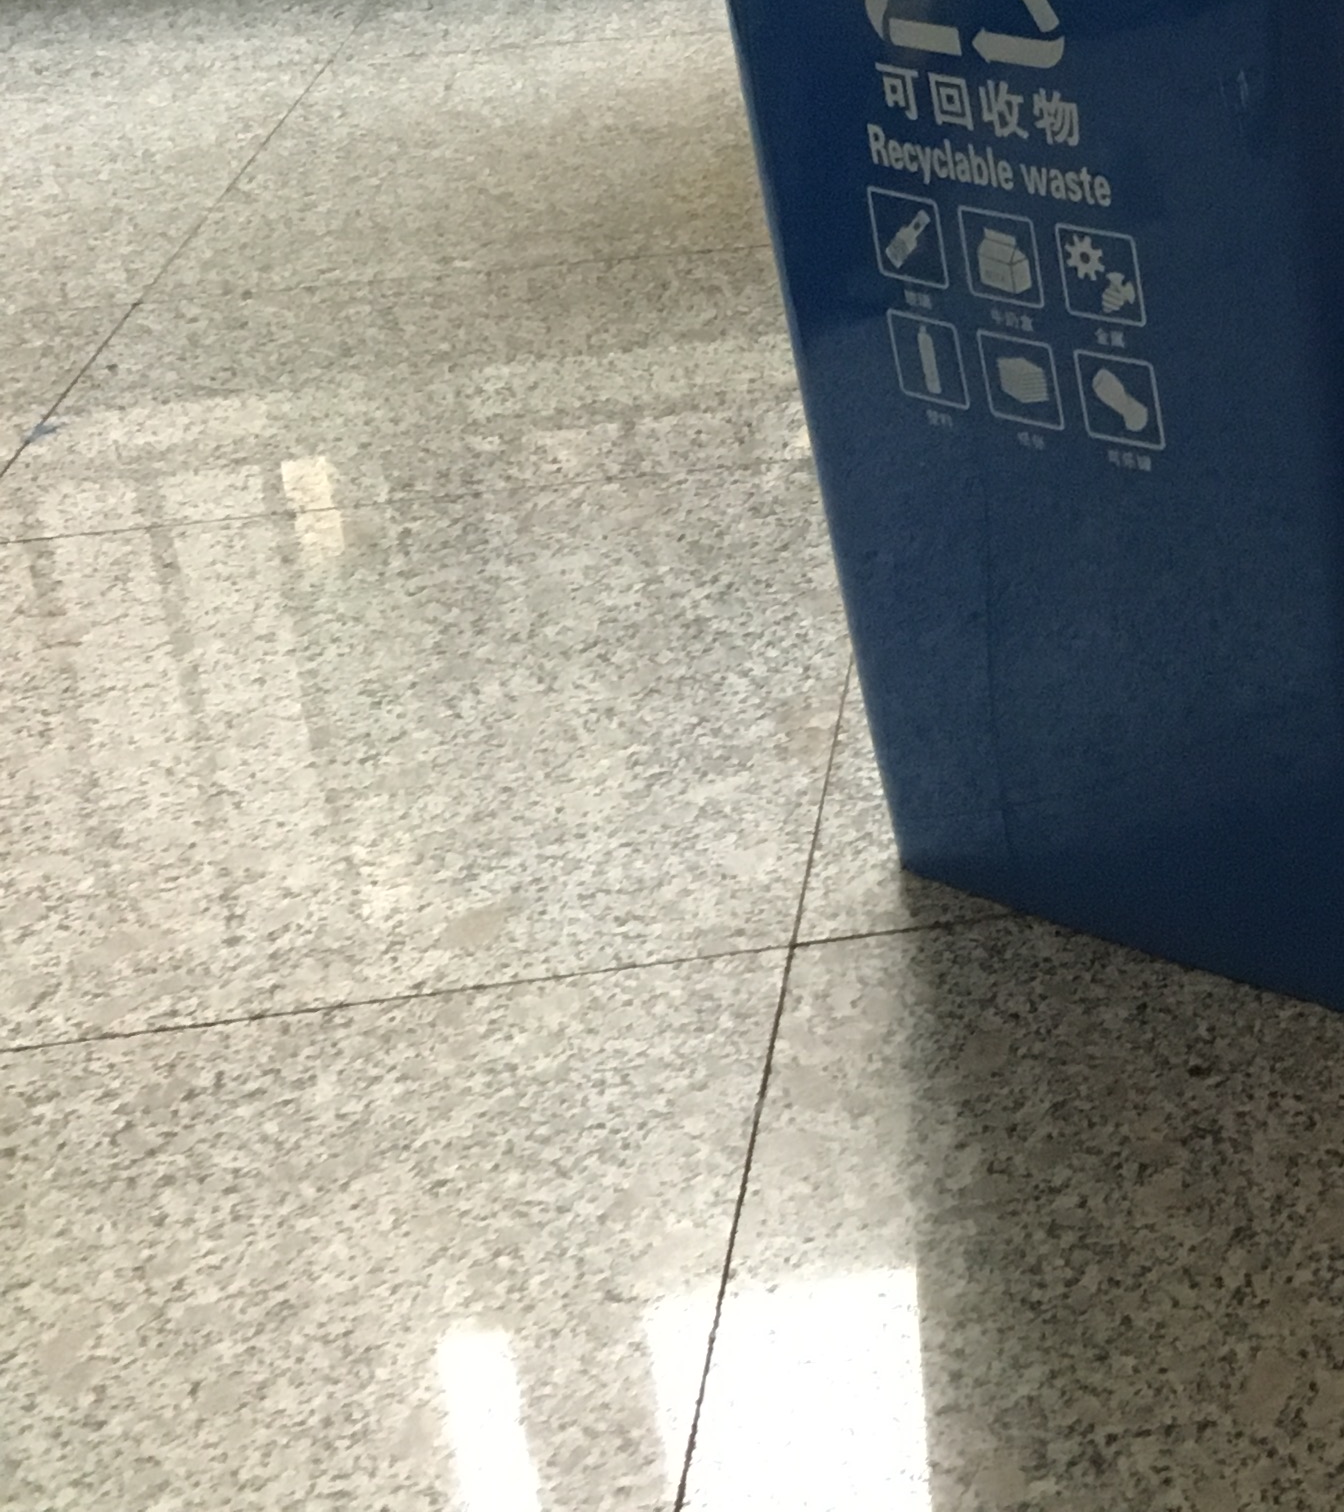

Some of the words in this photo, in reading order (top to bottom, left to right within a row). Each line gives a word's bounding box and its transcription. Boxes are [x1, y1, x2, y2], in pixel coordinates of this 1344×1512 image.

[876, 64, 1079, 146] 可回收物
[867, 124, 1014, 190] Recyclable
[1021, 163, 1111, 206] waste
